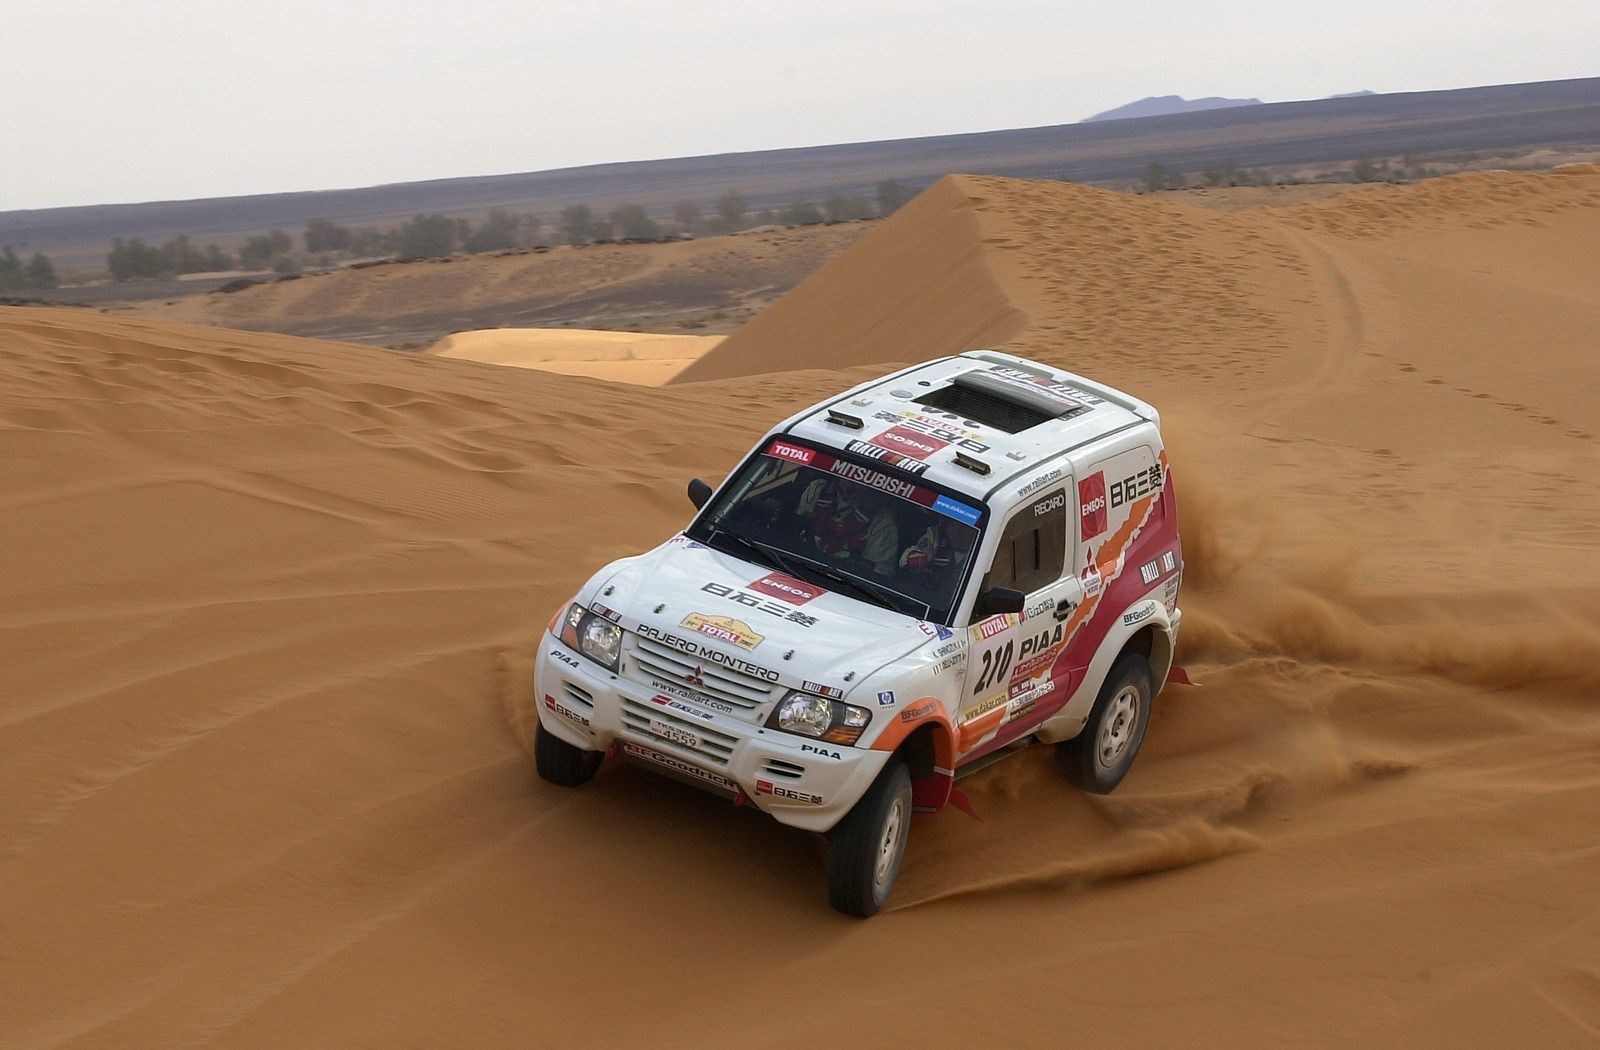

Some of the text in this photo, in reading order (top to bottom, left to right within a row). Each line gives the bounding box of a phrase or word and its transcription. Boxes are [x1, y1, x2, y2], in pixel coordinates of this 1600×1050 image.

[774, 444, 810, 462] TOTAL
[884, 432, 935, 453] ENEOS
[849, 441, 925, 474] RALLI ART
[830, 458, 917, 498] MITSUBISHI
[1110, 463, 1163, 509] 日石三菱
[1034, 494, 1065, 517] RECARO
[1081, 495, 1105, 517] ENEOS
[760, 577, 812, 600] ENEOS
[700, 582, 820, 628] 日石三菱
[701, 624, 737, 643] TOTAL
[981, 614, 1008, 636] TOTAL
[637, 623, 698, 653] PAJERO
[699, 647, 780, 681] MONTERO
[1018, 623, 1063, 661] PIAA
[551, 650, 580, 669] PIAA
[974, 638, 1014, 696] 210
[651, 680, 733, 714] www.ralliart.com
[965, 694, 1007, 720] www.dakar.com
[663, 730, 697, 747] 4559
[801, 744, 842, 760] PIAA
